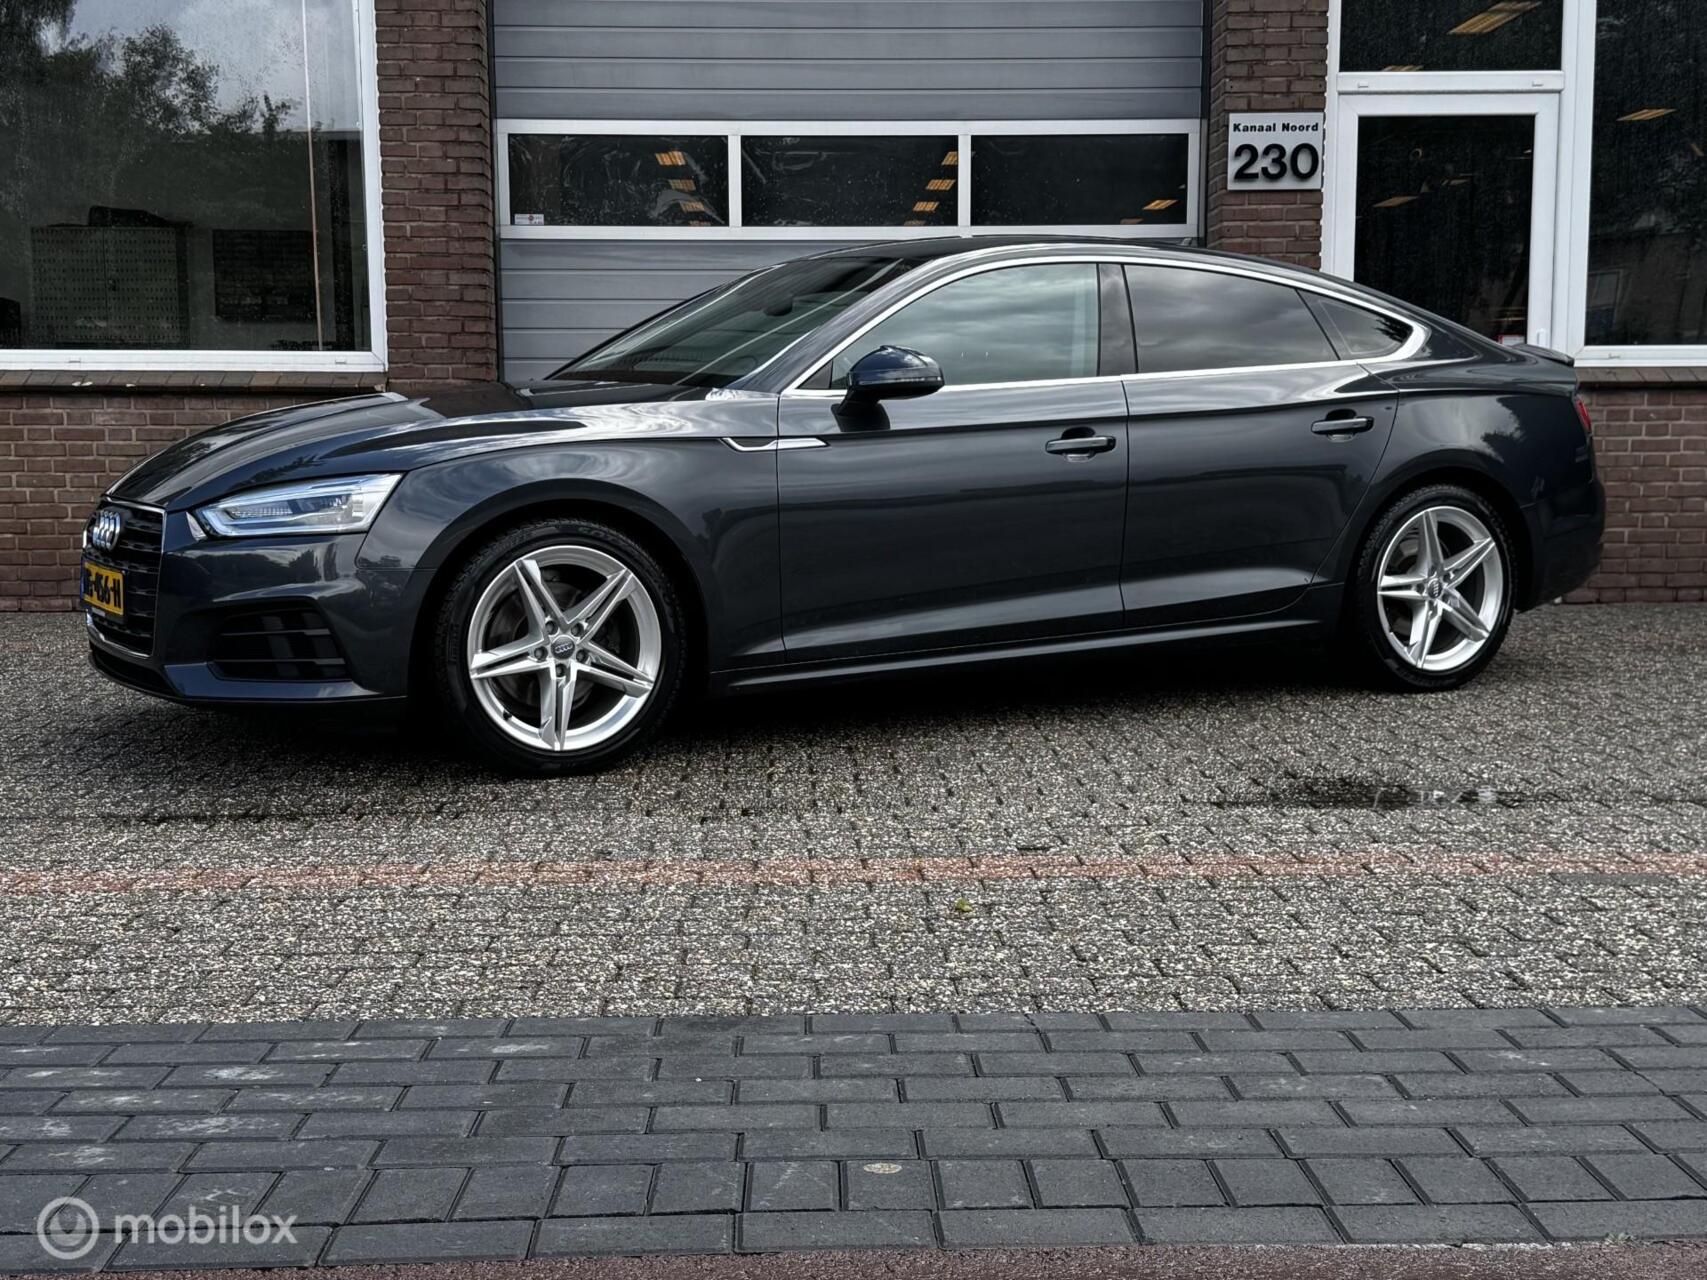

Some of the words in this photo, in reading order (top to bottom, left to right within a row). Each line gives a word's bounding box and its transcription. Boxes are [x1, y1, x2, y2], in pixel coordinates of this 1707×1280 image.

[1233, 123, 1276, 132] Kanaal
[1281, 122, 1319, 132] Noord
[1233, 143, 1319, 180] 230
